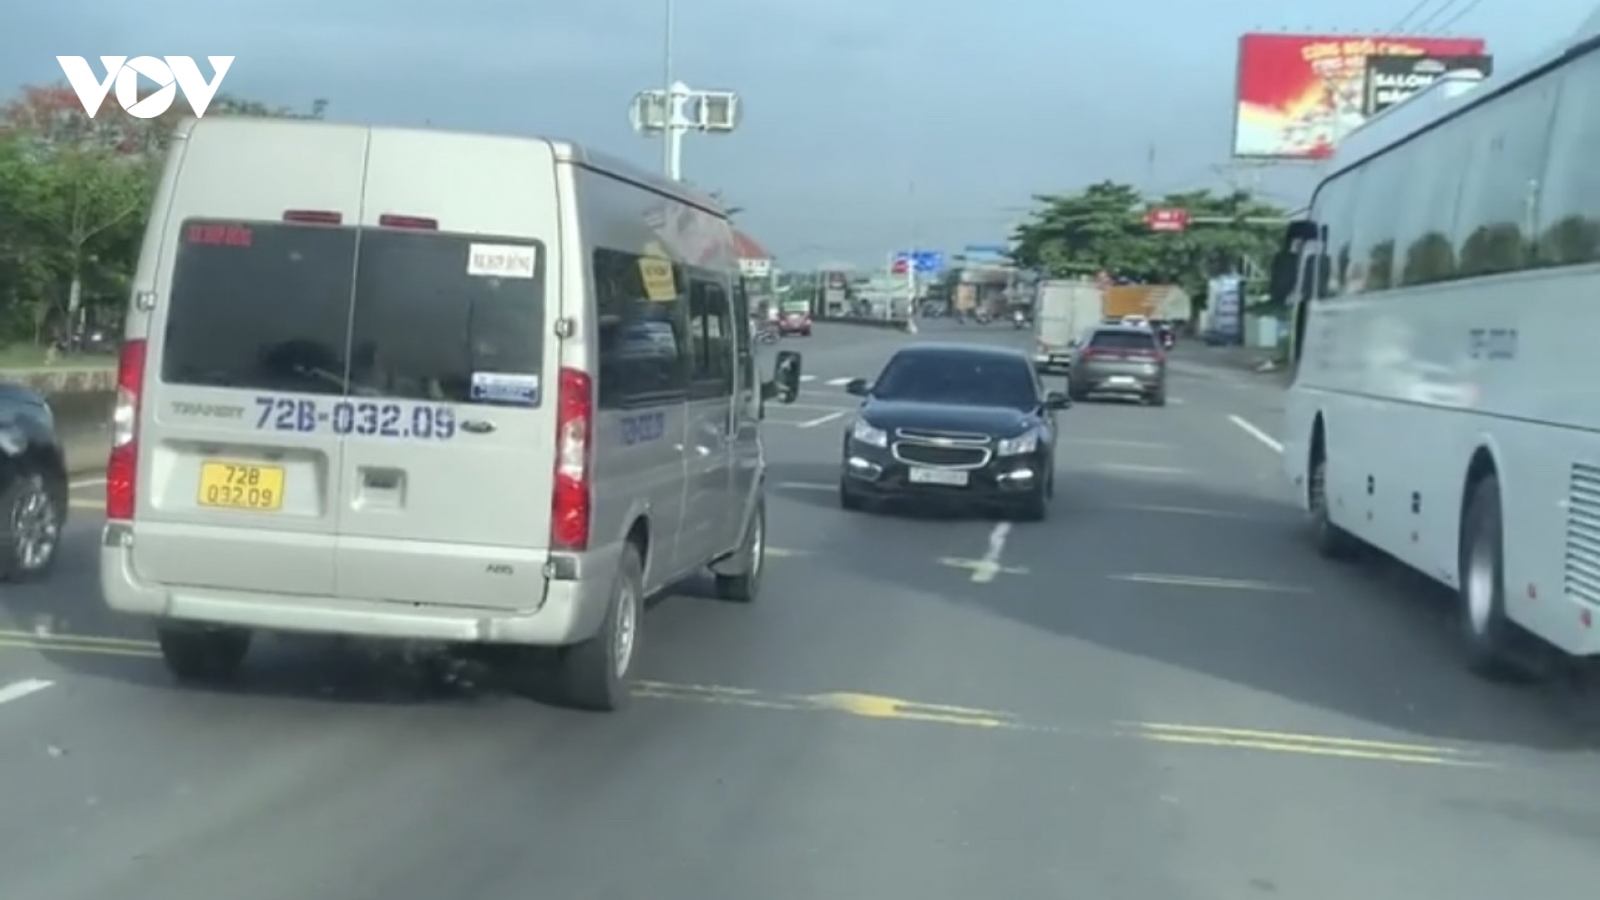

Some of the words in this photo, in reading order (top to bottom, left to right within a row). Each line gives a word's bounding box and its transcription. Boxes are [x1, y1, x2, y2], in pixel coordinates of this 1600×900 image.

[255, 396, 456, 440] 72B-032.09
[224, 466, 261, 486] 72B
[206, 486, 273, 507] 032.09
